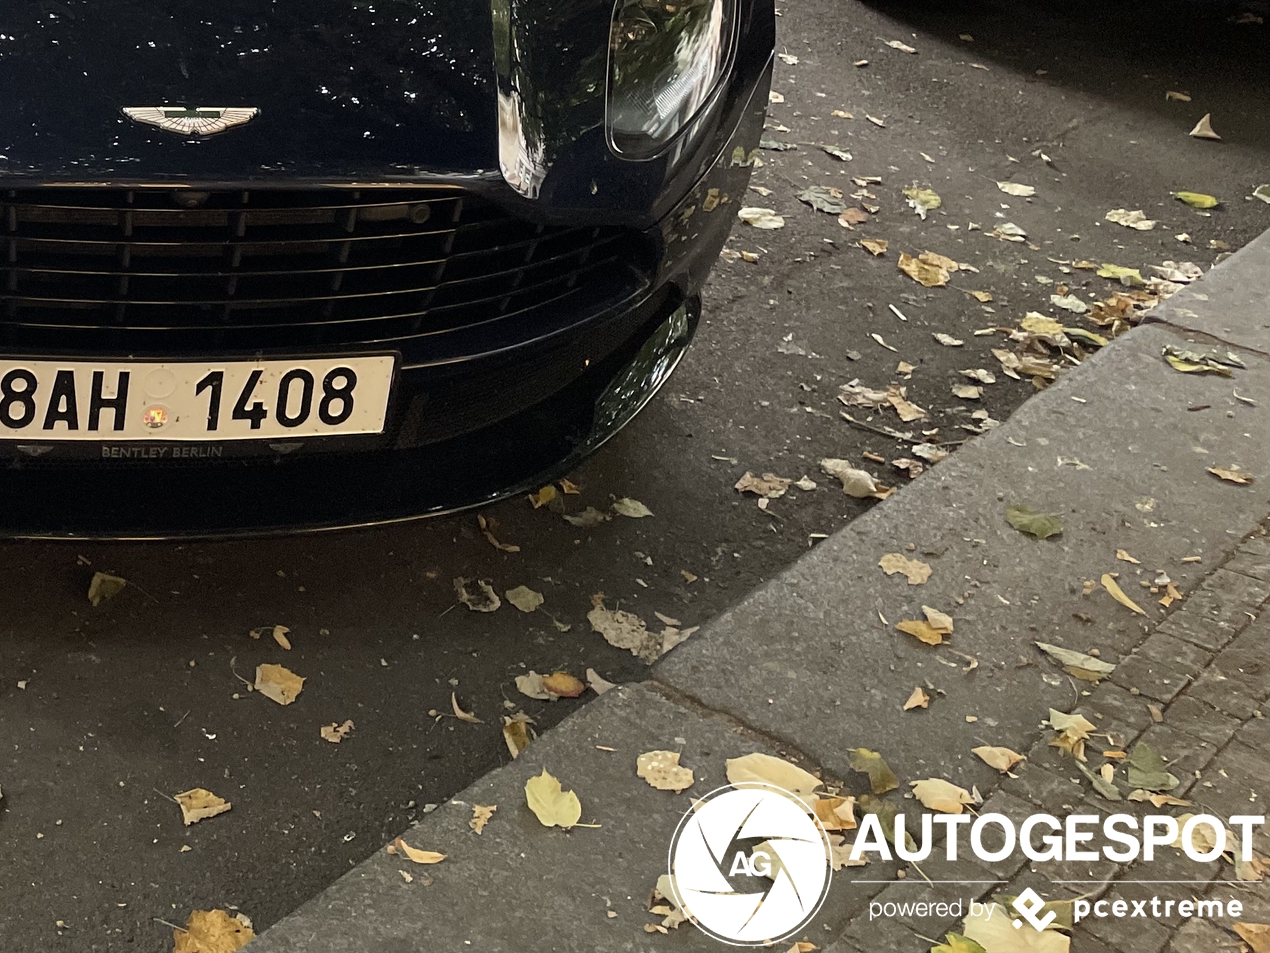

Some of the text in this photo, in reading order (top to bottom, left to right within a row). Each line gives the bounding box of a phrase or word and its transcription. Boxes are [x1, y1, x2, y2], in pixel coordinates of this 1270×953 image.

[195, 366, 357, 431] 1408
[101, 446, 223, 459] BENTLEY BERLIN
